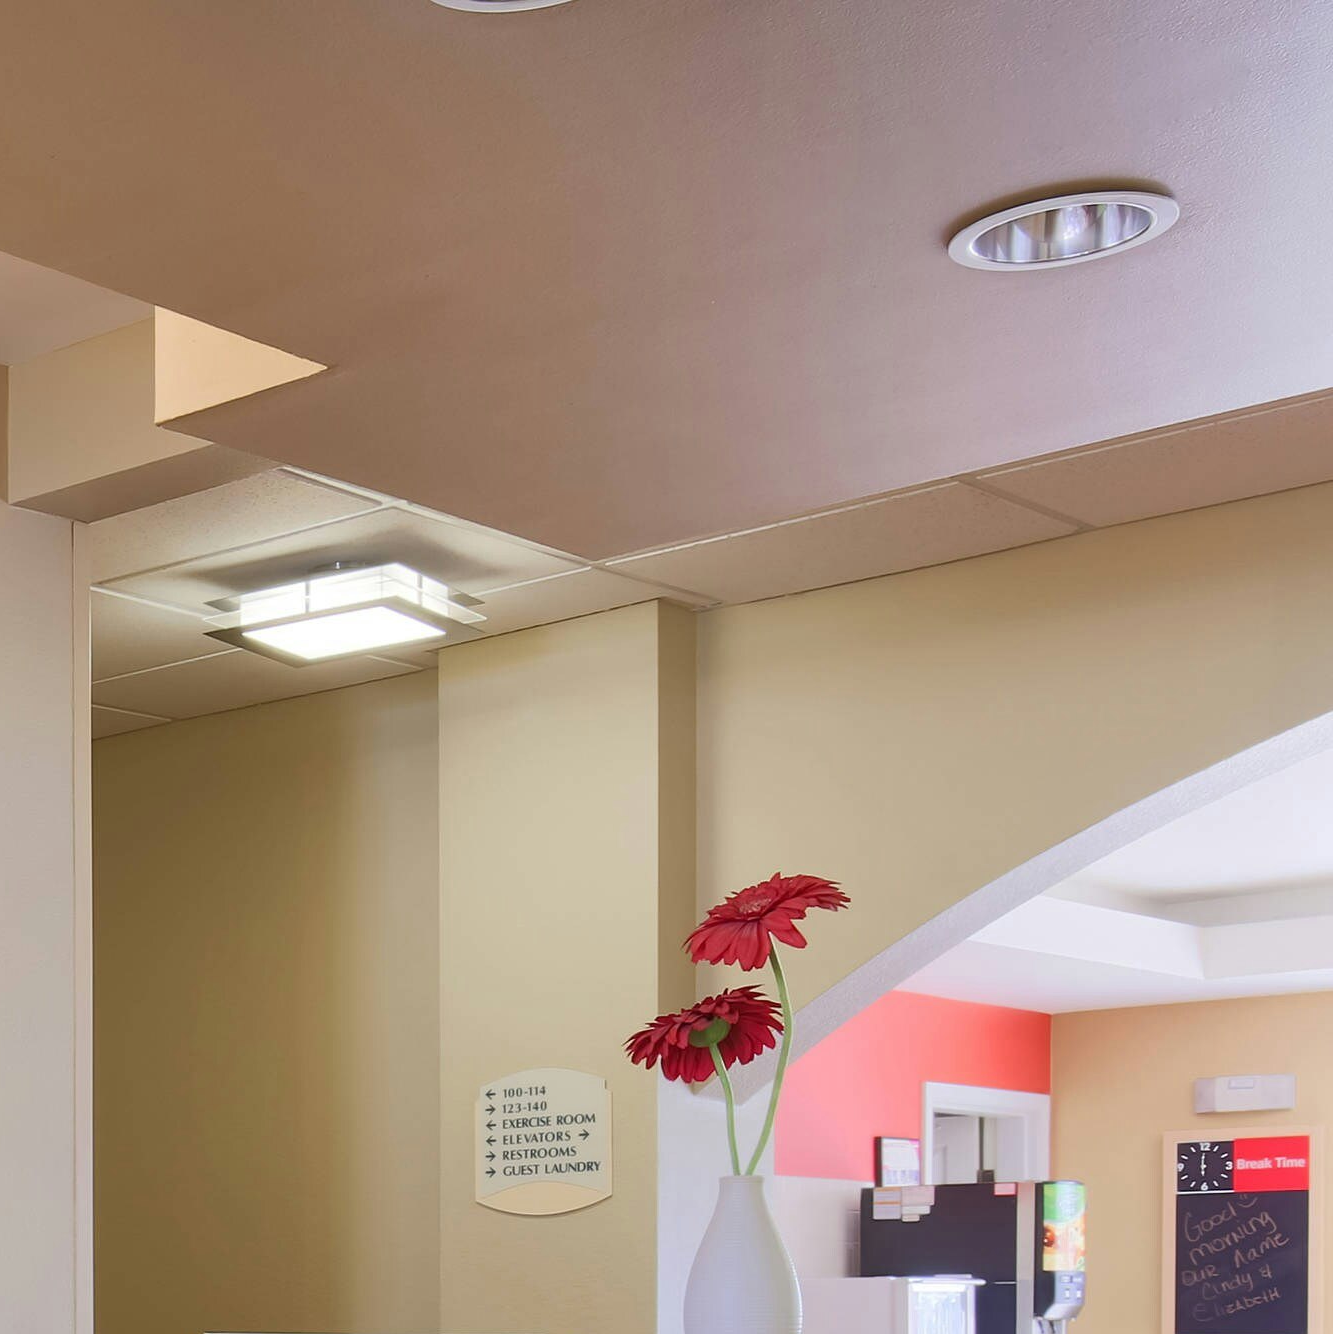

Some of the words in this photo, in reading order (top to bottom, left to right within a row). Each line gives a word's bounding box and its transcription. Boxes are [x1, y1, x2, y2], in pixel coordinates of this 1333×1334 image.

[503, 1086, 546, 1098] 100-114
[502, 1101, 547, 1114] 123-140
[502, 1116, 552, 1129] EXERCISE
[556, 1113, 596, 1125] ROOM
[502, 1130, 571, 1145] ELEVATORS
[502, 1146, 577, 1160] RESTROOMS
[1199, 1142, 1211, 1151] 12
[503, 1164, 539, 1176] GUEST
[545, 1161, 601, 1174] LAUNDRY
[1236, 1158, 1272, 1170] Break
[1275, 1157, 1306, 1168] Time
[1201, 1182, 1208, 1191] 6
